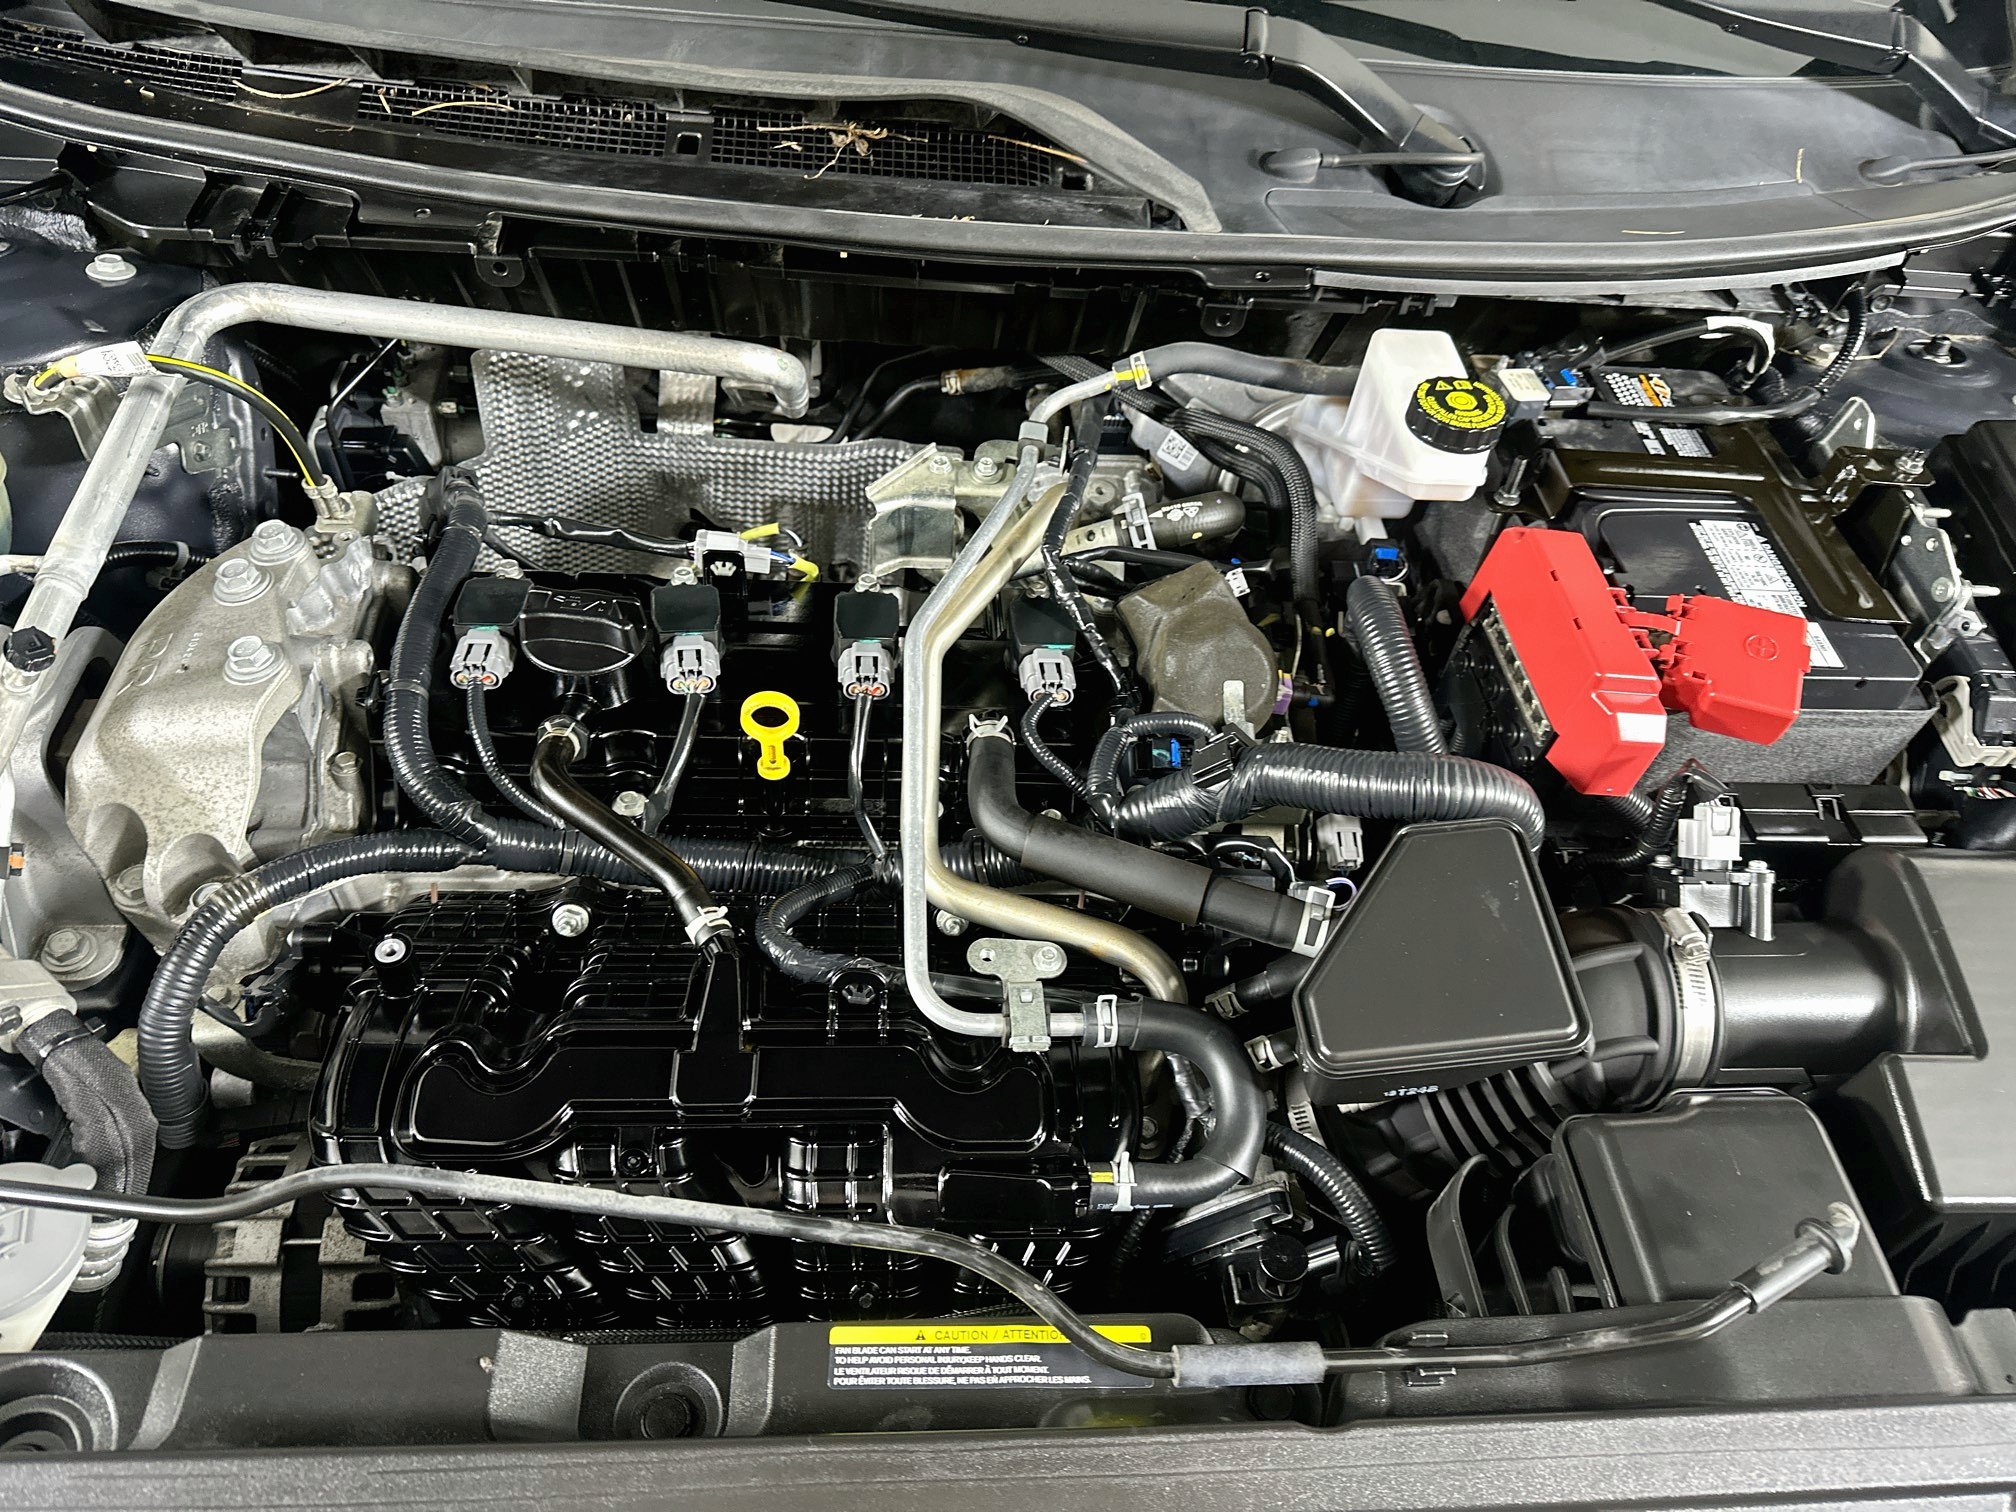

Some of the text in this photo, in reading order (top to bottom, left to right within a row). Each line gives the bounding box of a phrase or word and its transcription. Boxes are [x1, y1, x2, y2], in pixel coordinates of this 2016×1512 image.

[935, 1330, 988, 1340] CAUTION
[834, 1346, 851, 1354] FAN
[852, 1346, 878, 1354] BLADE
[879, 1346, 896, 1354] CAN
[897, 1346, 922, 1354] START
[922, 1346, 933, 1354] AT
[934, 1346, 951, 1354] ANY
[834, 1356, 846, 1364] TO
[847, 1356, 868, 1364] HELP
[868, 1356, 893, 1364] AVOID
[894, 1356, 936, 1364] PERSONAL
[985, 1355, 1013, 1363] HANDS
[833, 1367, 845, 1375] LE
[845, 1367, 896, 1375] VENTILATEUR
[897, 1367, 928, 1375] RISQUE
[928, 1366, 940, 1375] DE
[941, 1364, 984, 1375] DÉMARRER
[985, 1364, 992, 1374] À
[991, 1366, 1012, 1374] TOUT
[833, 1377, 858, 1386] POUR
[886, 1377, 912, 1385] TOUTE
[912, 1377, 956, 1386] BLESSURE,
[956, 1376, 970, 1384] NE
[970, 1376, 986, 1384] PAS
[998, 1375, 1047, 1384] APPROCHER
[1048, 1376, 1063, 1384] LES
